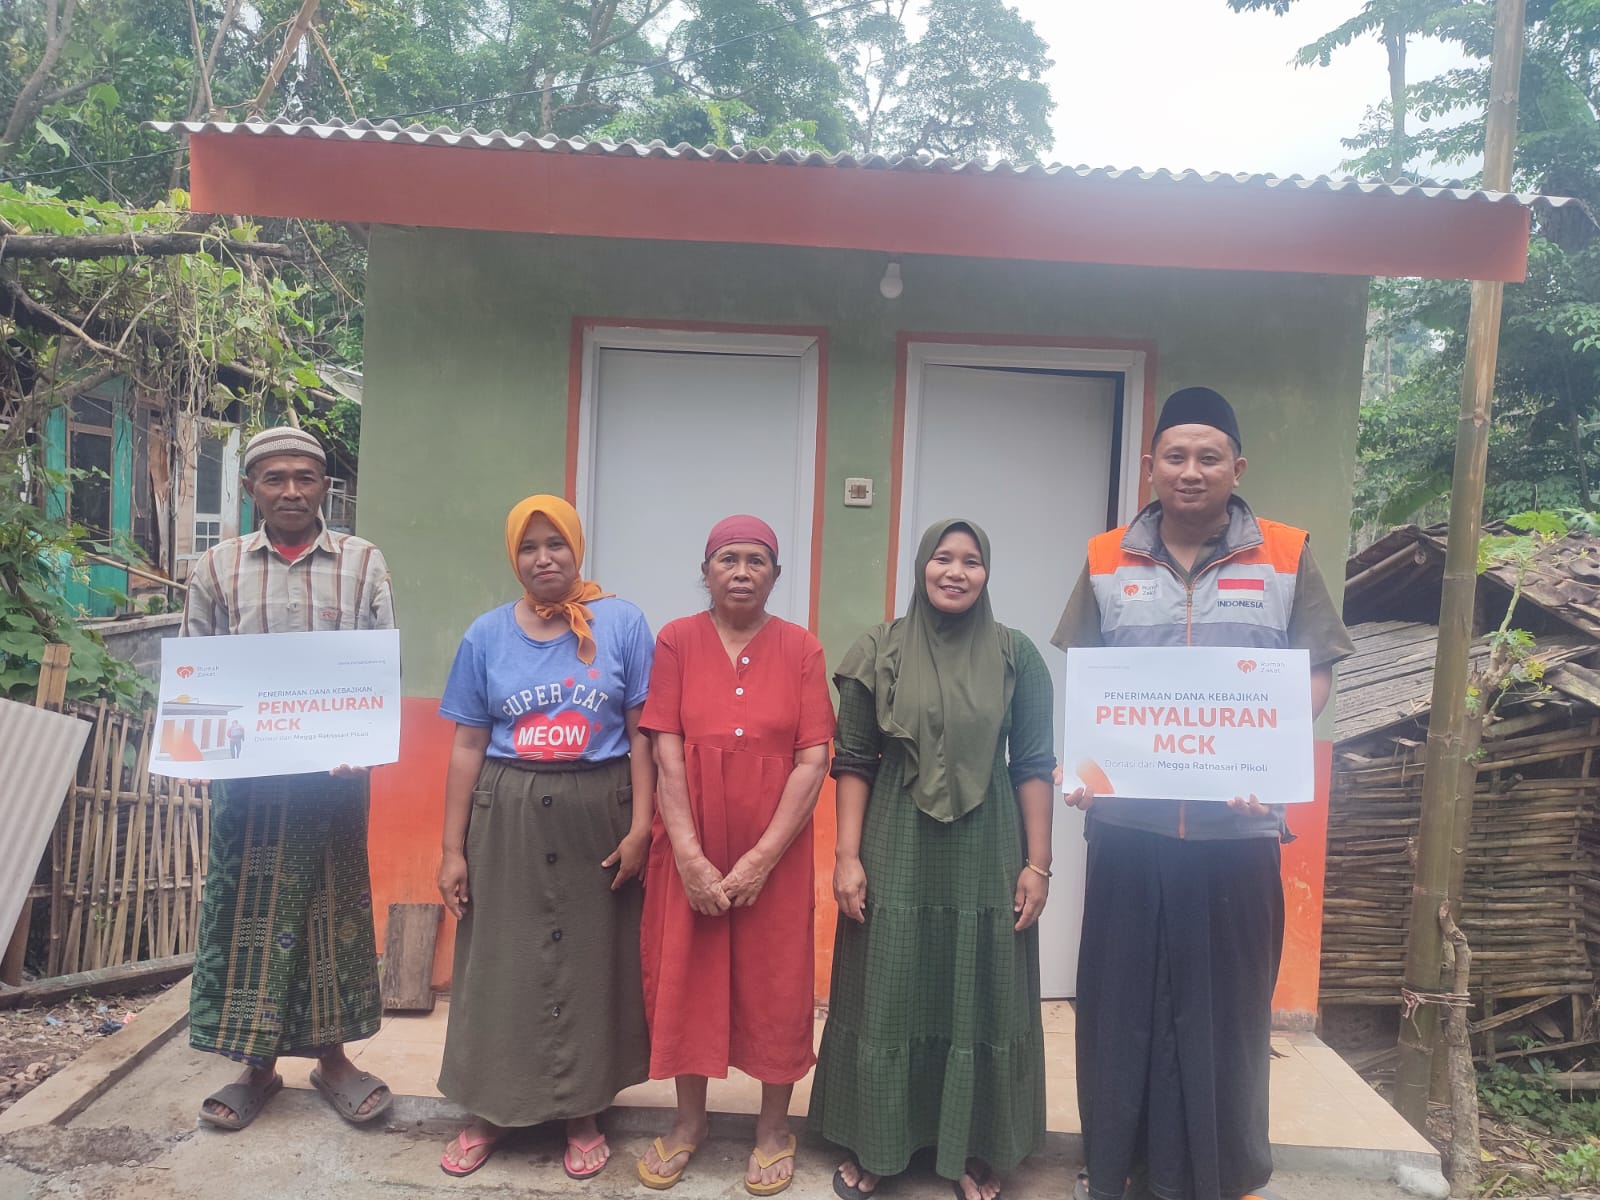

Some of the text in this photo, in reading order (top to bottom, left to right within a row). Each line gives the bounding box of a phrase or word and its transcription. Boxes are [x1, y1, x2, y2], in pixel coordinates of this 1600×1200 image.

[1217, 601, 1264, 609] INDONESIA
[258, 686, 373, 698] PENERIMAAN DANA KEBAJIKAN
[572, 684, 608, 713] CAT
[1104, 692, 1269, 702] PENERIMAAN DANA KEBAJIKAN
[257, 696, 384, 715] PENYALURAN
[255, 718, 301, 732] MCK
[1096, 705, 1278, 729] PENYALURAN
[517, 725, 587, 746] MEOW
[1153, 734, 1216, 755] MCK
[1104, 759, 1268, 773] Donasi dari Megga Ratnasari Pikoli
